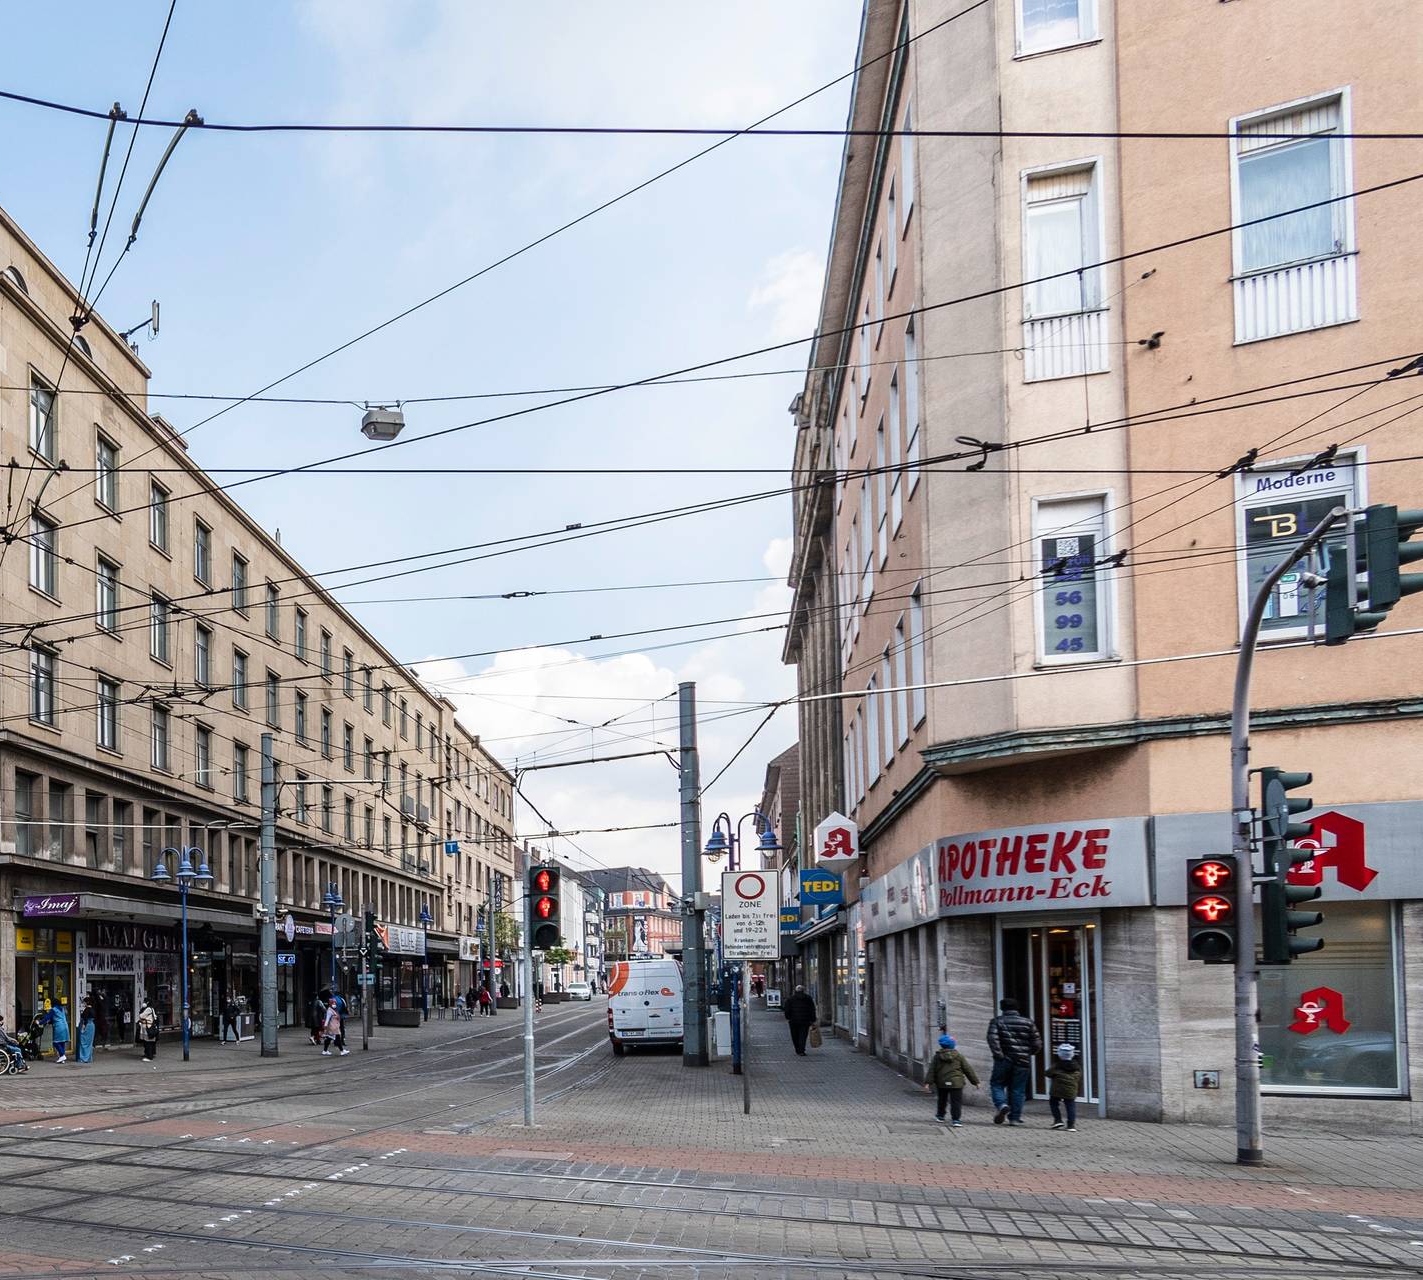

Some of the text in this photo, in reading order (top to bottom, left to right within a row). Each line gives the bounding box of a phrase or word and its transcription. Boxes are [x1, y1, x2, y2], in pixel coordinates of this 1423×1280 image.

[1256, 470, 1336, 493] Moderne
[1055, 590, 1082, 606] 56
[1055, 614, 1083, 629] 99
[1054, 637, 1084, 652] 45
[938, 828, 1111, 884] APOTHEKE
[802, 880, 839, 893] TEDi
[939, 874, 1113, 908] Pollmann-Eck
[779, 914, 798, 923] EDi
